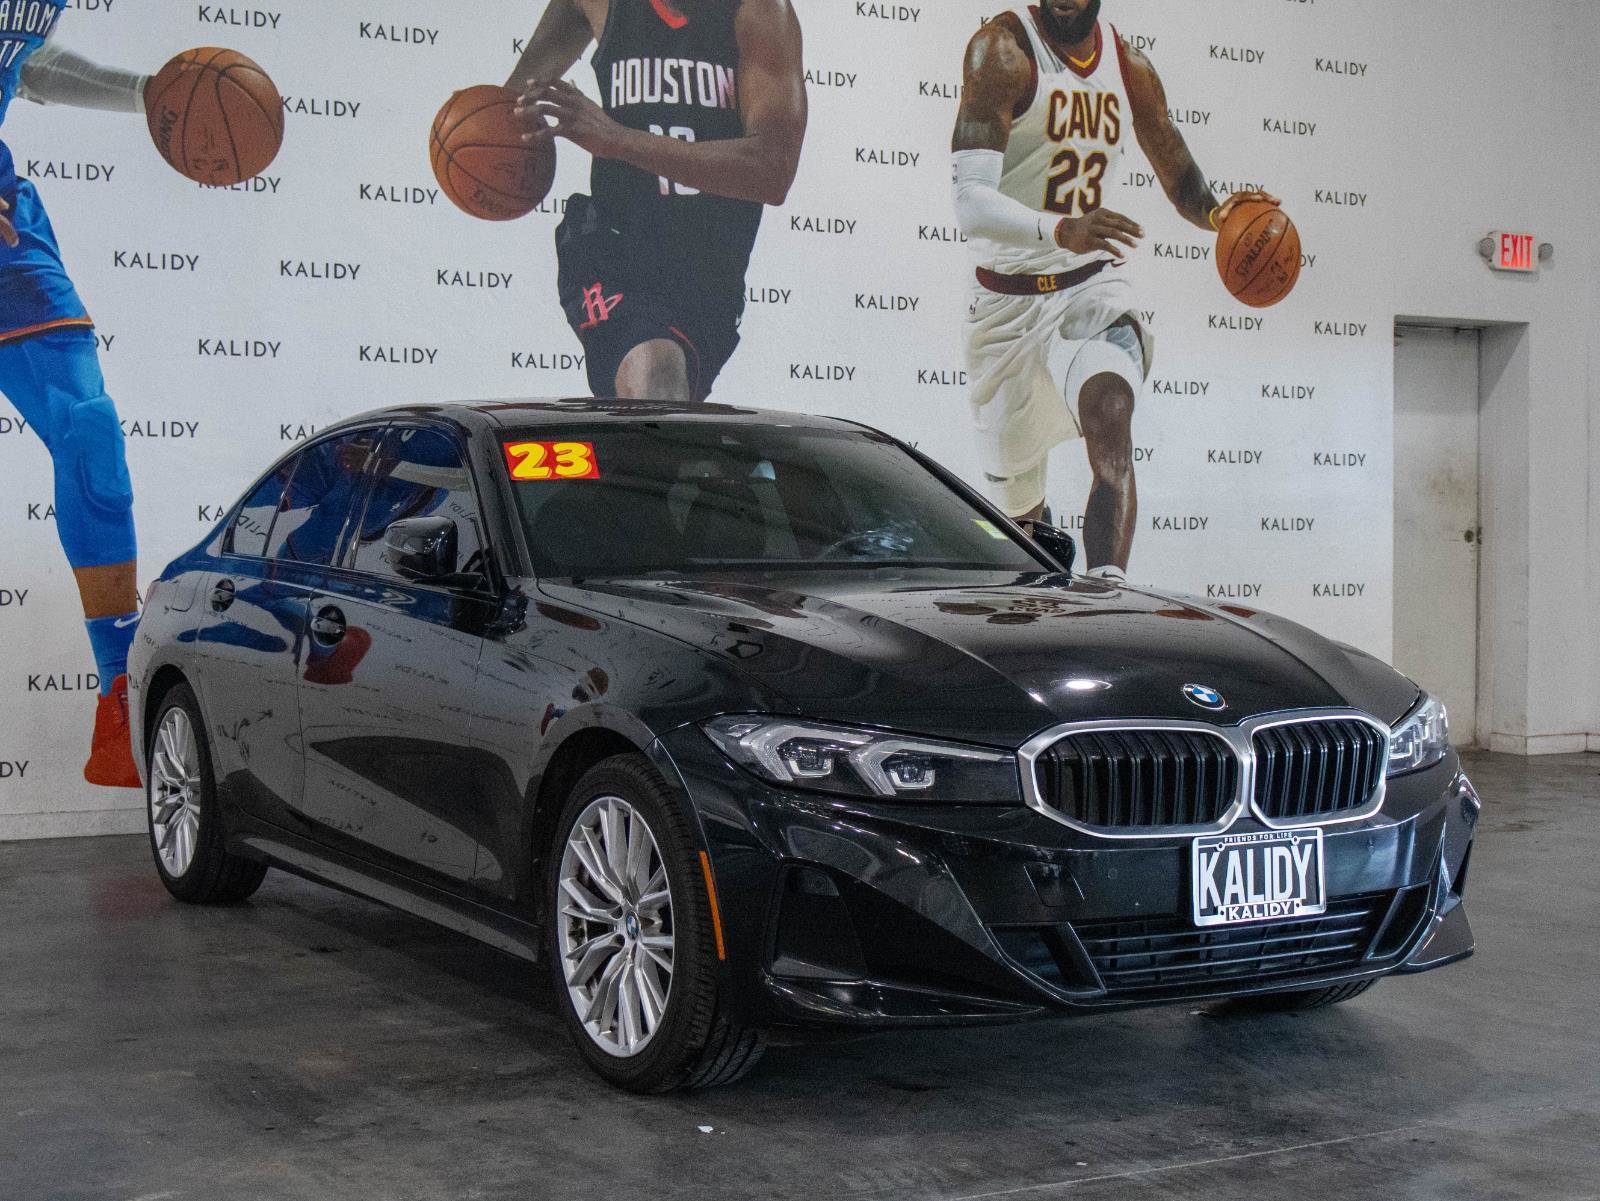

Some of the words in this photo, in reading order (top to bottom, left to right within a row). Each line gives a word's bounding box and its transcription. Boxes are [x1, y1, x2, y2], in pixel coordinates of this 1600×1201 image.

[199, 6, 281, 28] KALIDY
[856, 2, 920, 22] KALIDY
[360, 22, 438, 44] KALIDY
[1210, 46, 1264, 63] KALIDY
[1316, 58, 1367, 76] KALIDY
[610, 58, 736, 109] HOUSTON
[805, 71, 856, 88] ALIDY
[919, 81, 961, 98] KALI
[283, 97, 360, 117] KALIDY
[1046, 88, 1121, 146] CAVS
[1167, 109, 1210, 125] ALIDY
[1263, 119, 1316, 135] KALIDY
[856, 148, 919, 166] KALIDY
[27, 160, 114, 181] KALIDY
[1043, 148, 1108, 216] 23
[360, 184, 438, 204] KALIDY
[1315, 190, 1366, 206] KALIDY
[791, 216, 856, 234] KALIDY
[919, 225, 968, 243] KALID
[1154, 244, 1209, 259] KALIDY
[1501, 234, 1533, 267] EXIT
[114, 251, 198, 271] KALIDY
[281, 260, 360, 279] KALIDY
[437, 270, 512, 288] KALIDY
[1036, 275, 1057, 292] CLE
[743, 288, 791, 304] LIDY
[855, 294, 918, 310] KALIDY
[1209, 315, 1262, 330] KALIDY
[1315, 322, 1366, 336] KALIDY
[199, 339, 280, 357] KALIDY
[360, 346, 437, 363] KALIDY
[512, 353, 584, 369] KALIDY
[790, 364, 855, 380] KALIDY
[918, 370, 967, 386] KALID
[1153, 380, 1209, 395] KALIDY
[1262, 385, 1314, 399] KALIDY
[508, 443, 592, 479] 23
[1208, 450, 1262, 464] KALIDY
[1314, 453, 1365, 466] KALIDY
[1060, 516, 1085, 529] LID
[1153, 517, 1208, 530] KALIDY
[1261, 518, 1314, 531] KALIDY
[1207, 584, 1261, 597] KALIDY
[1313, 583, 1364, 596] KALIDY
[28, 674, 98, 691] KALID
[1224, 835, 1257, 843] FRIENDS
[1259, 833, 1275, 841] FOR
[1276, 832, 1293, 840] LIFE
[1200, 844, 1313, 909] KALIDY
[1228, 901, 1293, 921] KALIDY
